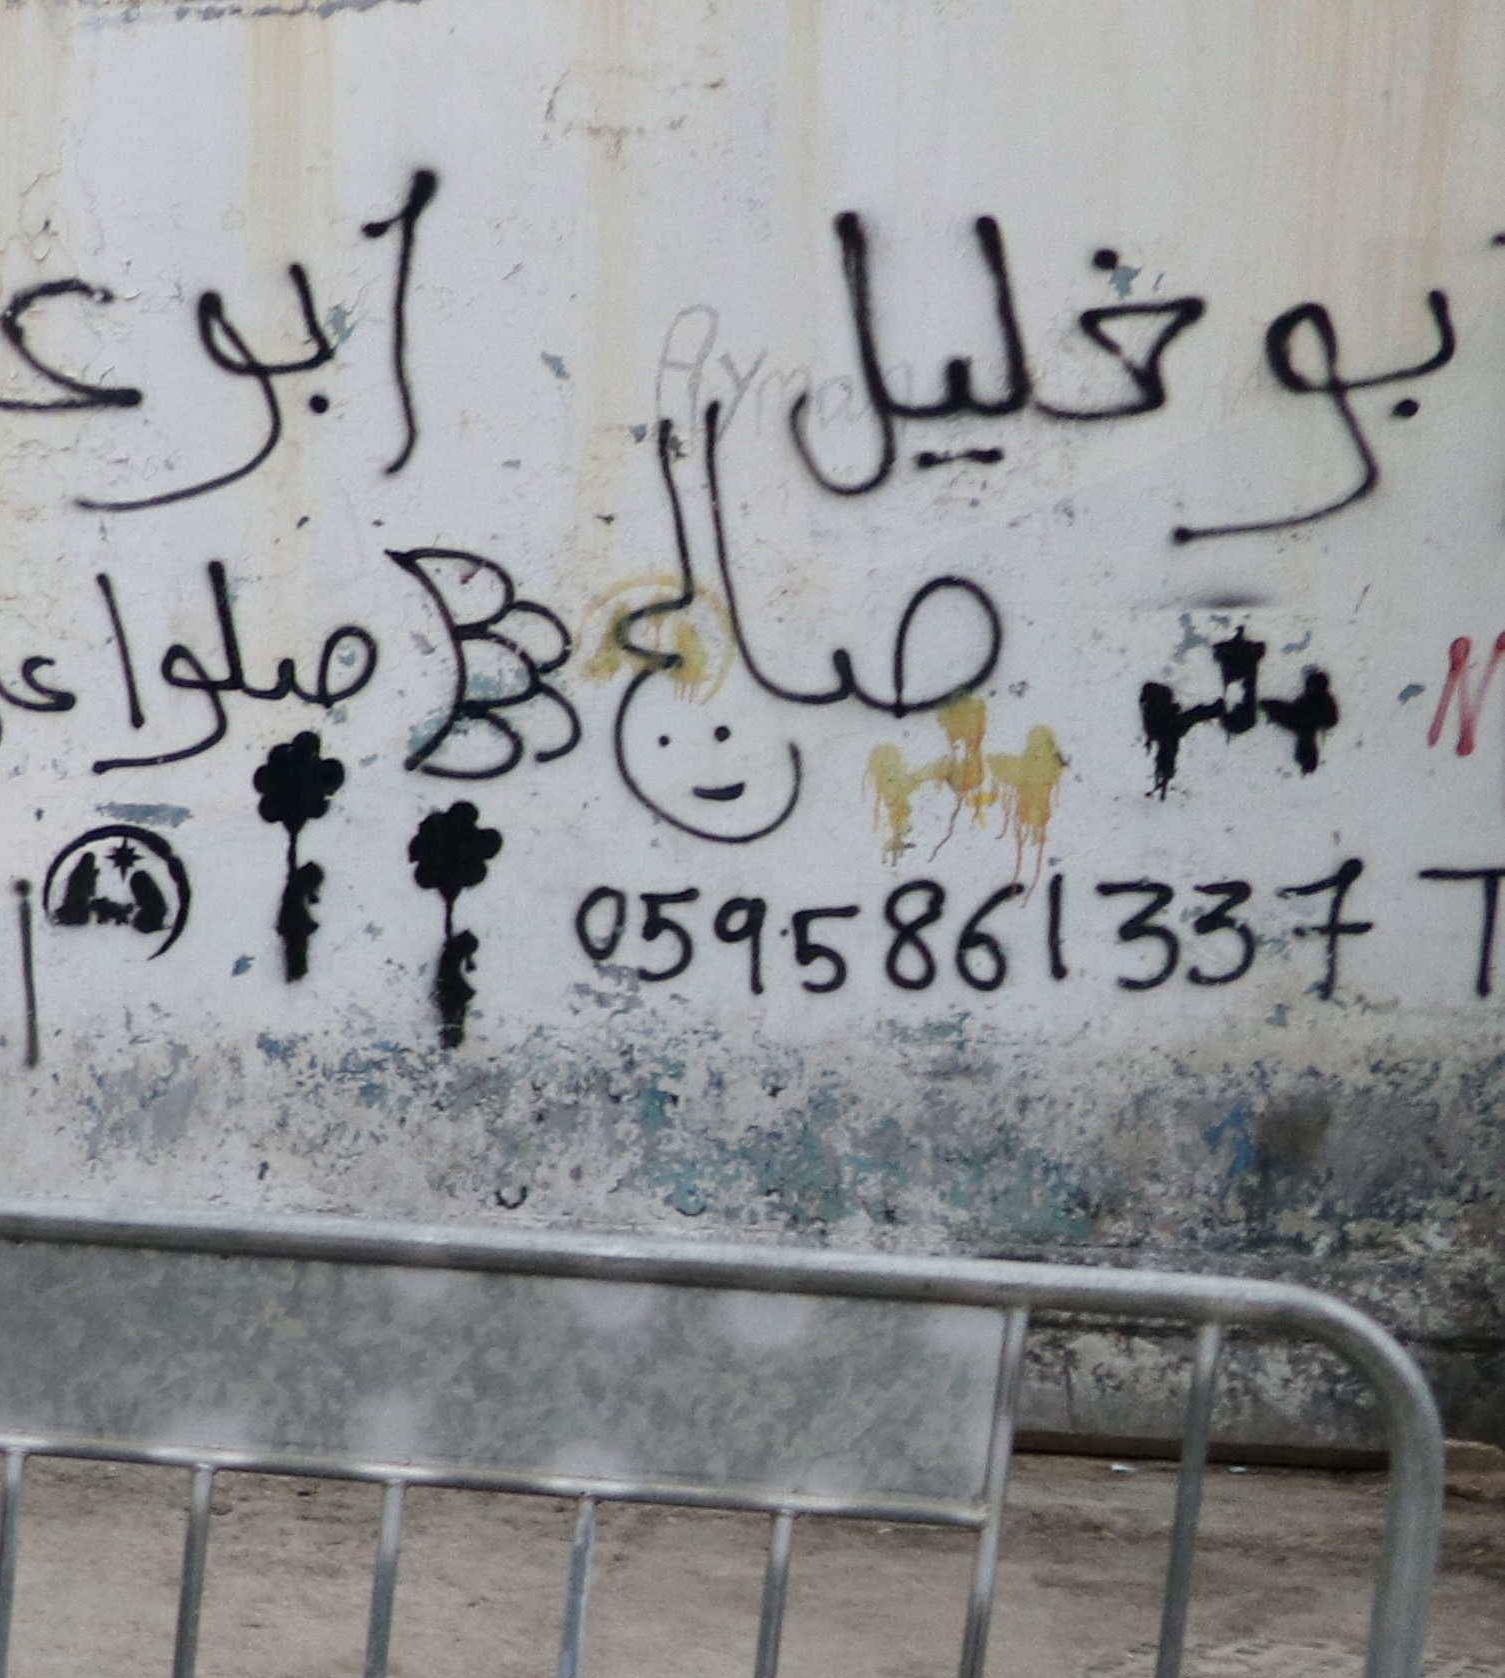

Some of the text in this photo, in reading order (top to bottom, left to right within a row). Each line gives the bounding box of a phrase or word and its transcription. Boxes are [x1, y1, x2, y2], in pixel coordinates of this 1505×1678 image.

[792, 209, 1205, 497] خليل
[91, 559, 378, 775] صلوا
[574, 857, 1374, 998] 0595861337
